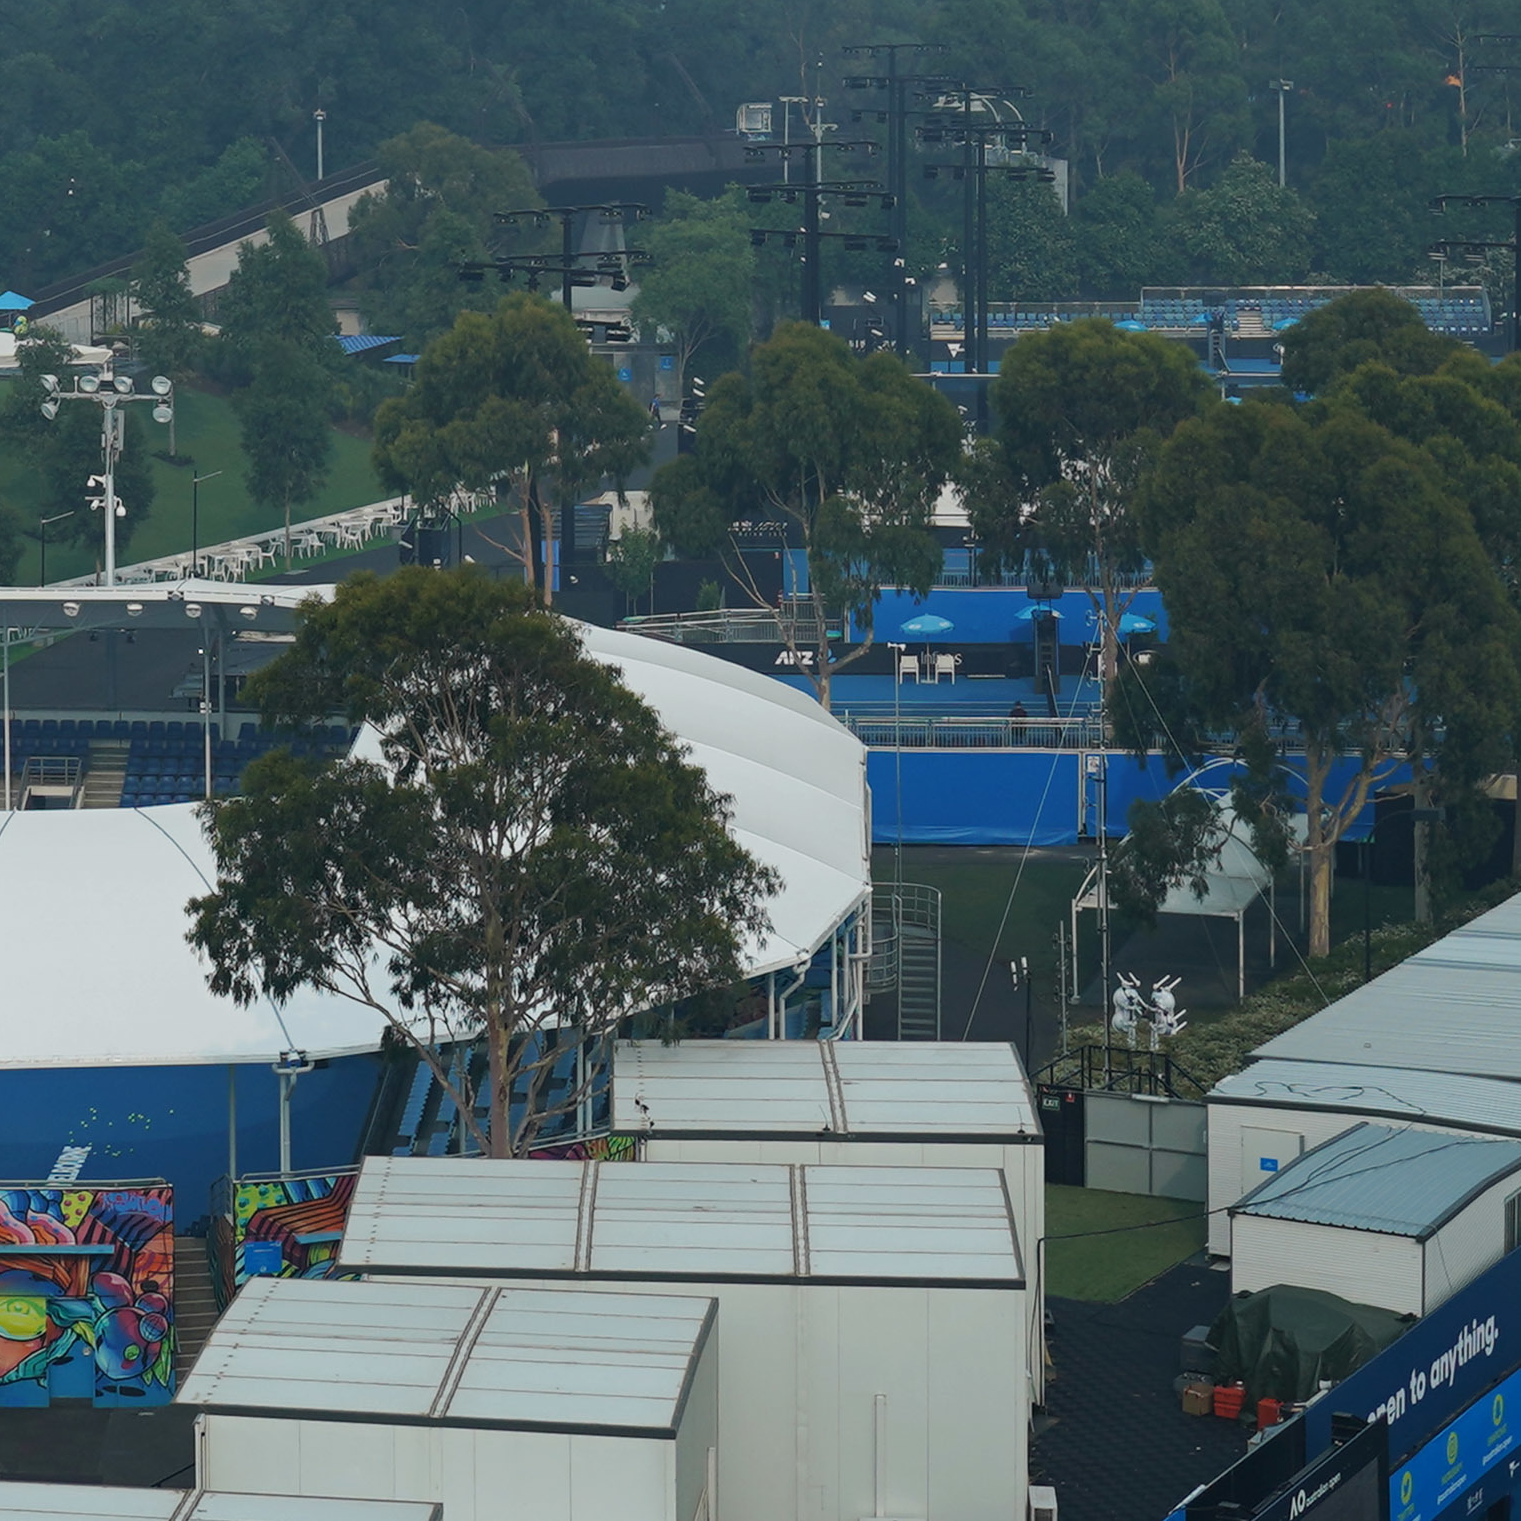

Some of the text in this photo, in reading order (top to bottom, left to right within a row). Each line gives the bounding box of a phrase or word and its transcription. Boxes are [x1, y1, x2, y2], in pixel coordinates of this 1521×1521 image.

[774, 651, 813, 665] ANZ
[920, 651, 962, 666] Infs
[1409, 1368, 1426, 1405] to
[1429, 1315, 1500, 1390] anything.
